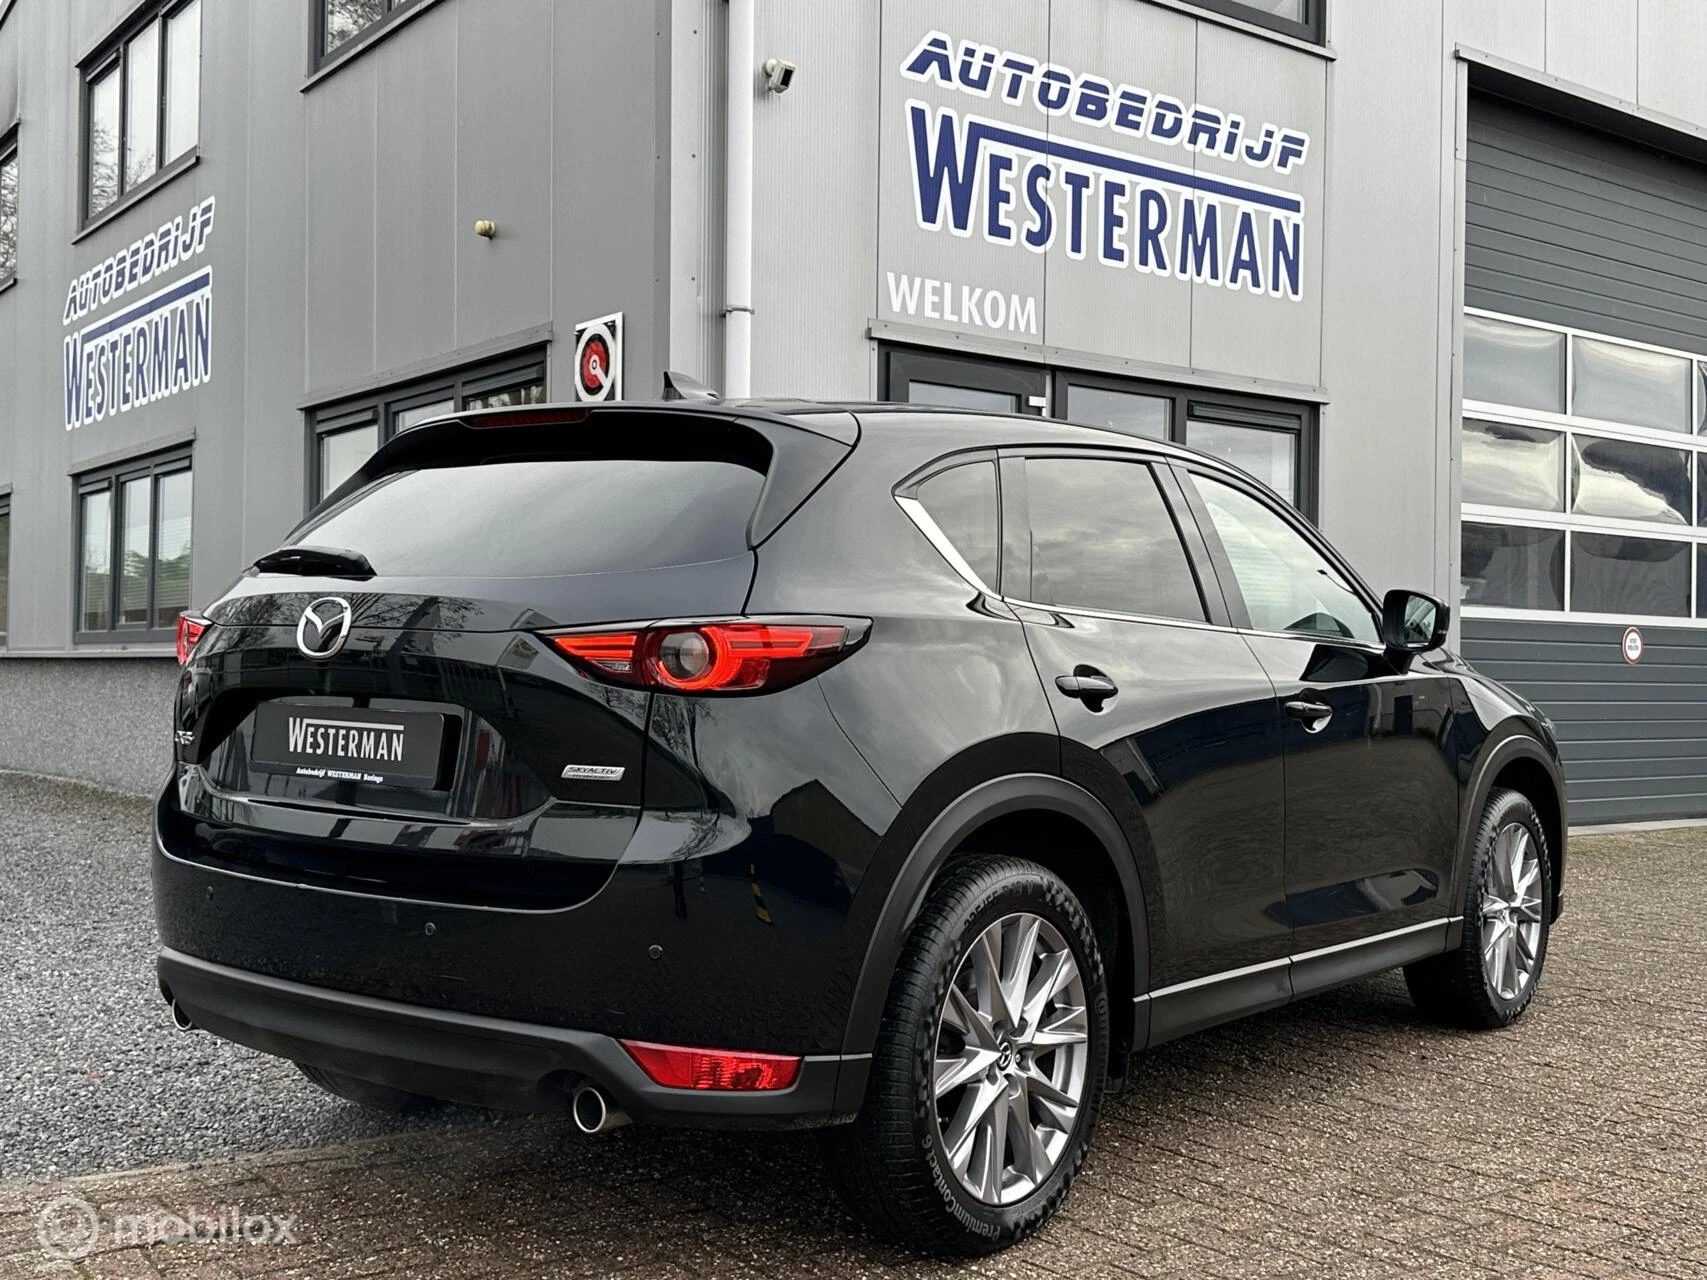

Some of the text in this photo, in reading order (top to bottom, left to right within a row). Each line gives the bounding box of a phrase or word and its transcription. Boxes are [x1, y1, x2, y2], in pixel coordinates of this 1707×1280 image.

[905, 36, 1306, 171] AUTOBEDRIJF
[908, 103, 1303, 298] WESTERMAN
[887, 272, 1037, 335] WELKOM
[64, 293, 212, 429] WESTERMAN
[288, 717, 404, 761] WESTERMAN
[327, 769, 361, 780] WESTERMAN
[926, 1148, 1001, 1240] PremiumContact
